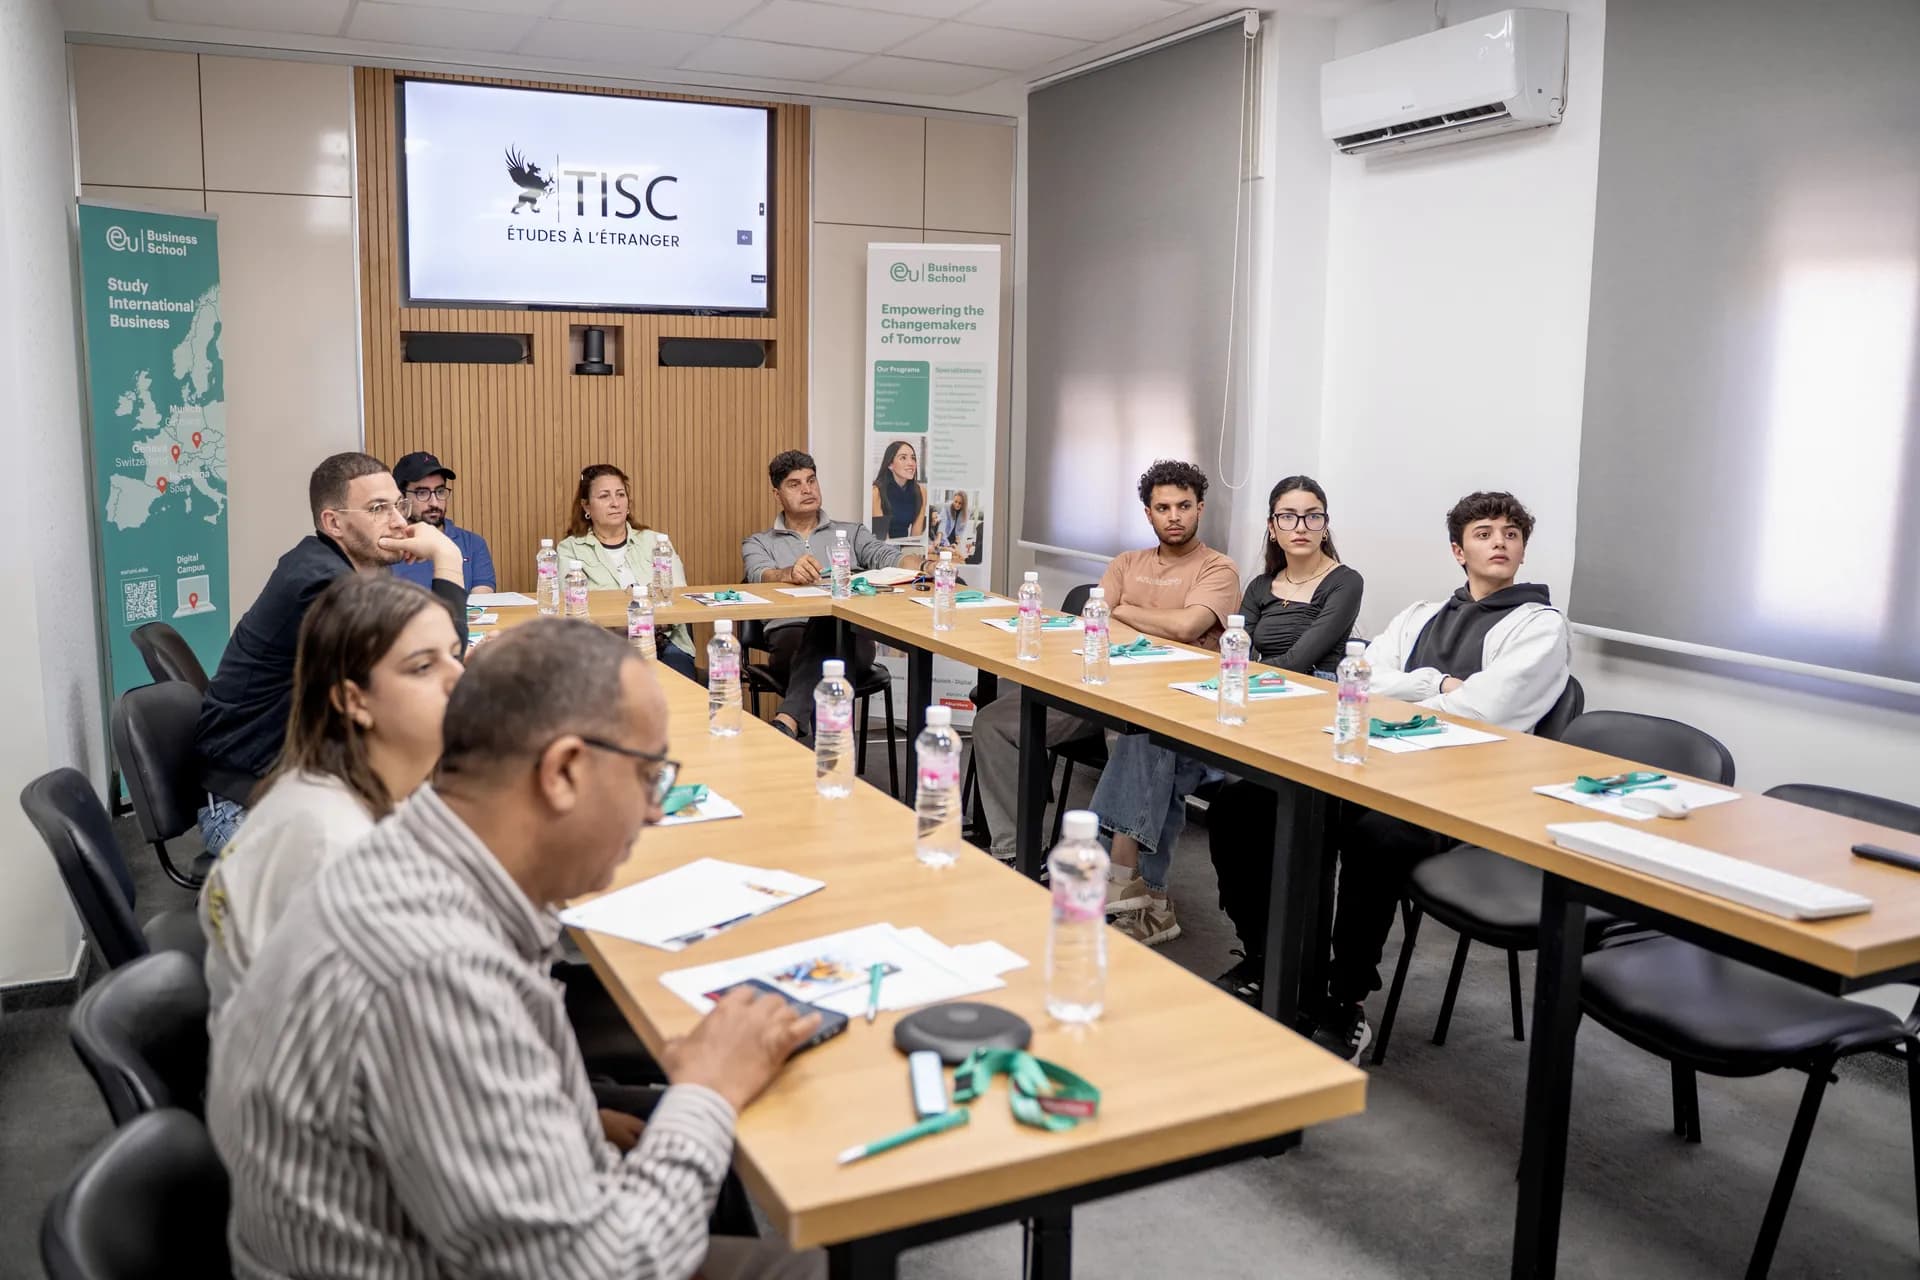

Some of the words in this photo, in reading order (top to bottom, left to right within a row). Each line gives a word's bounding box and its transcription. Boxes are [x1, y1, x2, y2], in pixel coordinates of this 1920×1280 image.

[563, 170, 678, 221] TISC
[147, 230, 198, 245] Business
[507, 225, 567, 243] ÉTUDES
[572, 226, 583, 243] À
[588, 228, 680, 248] L’ÉTRANGER
[147, 243, 187, 257] School
[928, 263, 977, 272] Business
[928, 273, 966, 283] School
[107, 277, 149, 296] Study
[109, 296, 195, 313] International
[881, 304, 961, 317] Empowering
[964, 304, 984, 316] the
[110, 314, 170, 329] Business
[881, 319, 977, 332] Changemakers
[881, 333, 893, 344] of
[897, 334, 961, 344] Tomorrow
[131, 444, 168, 455] Gen
[176, 553, 199, 565] Digital
[177, 564, 205, 574] Campus
